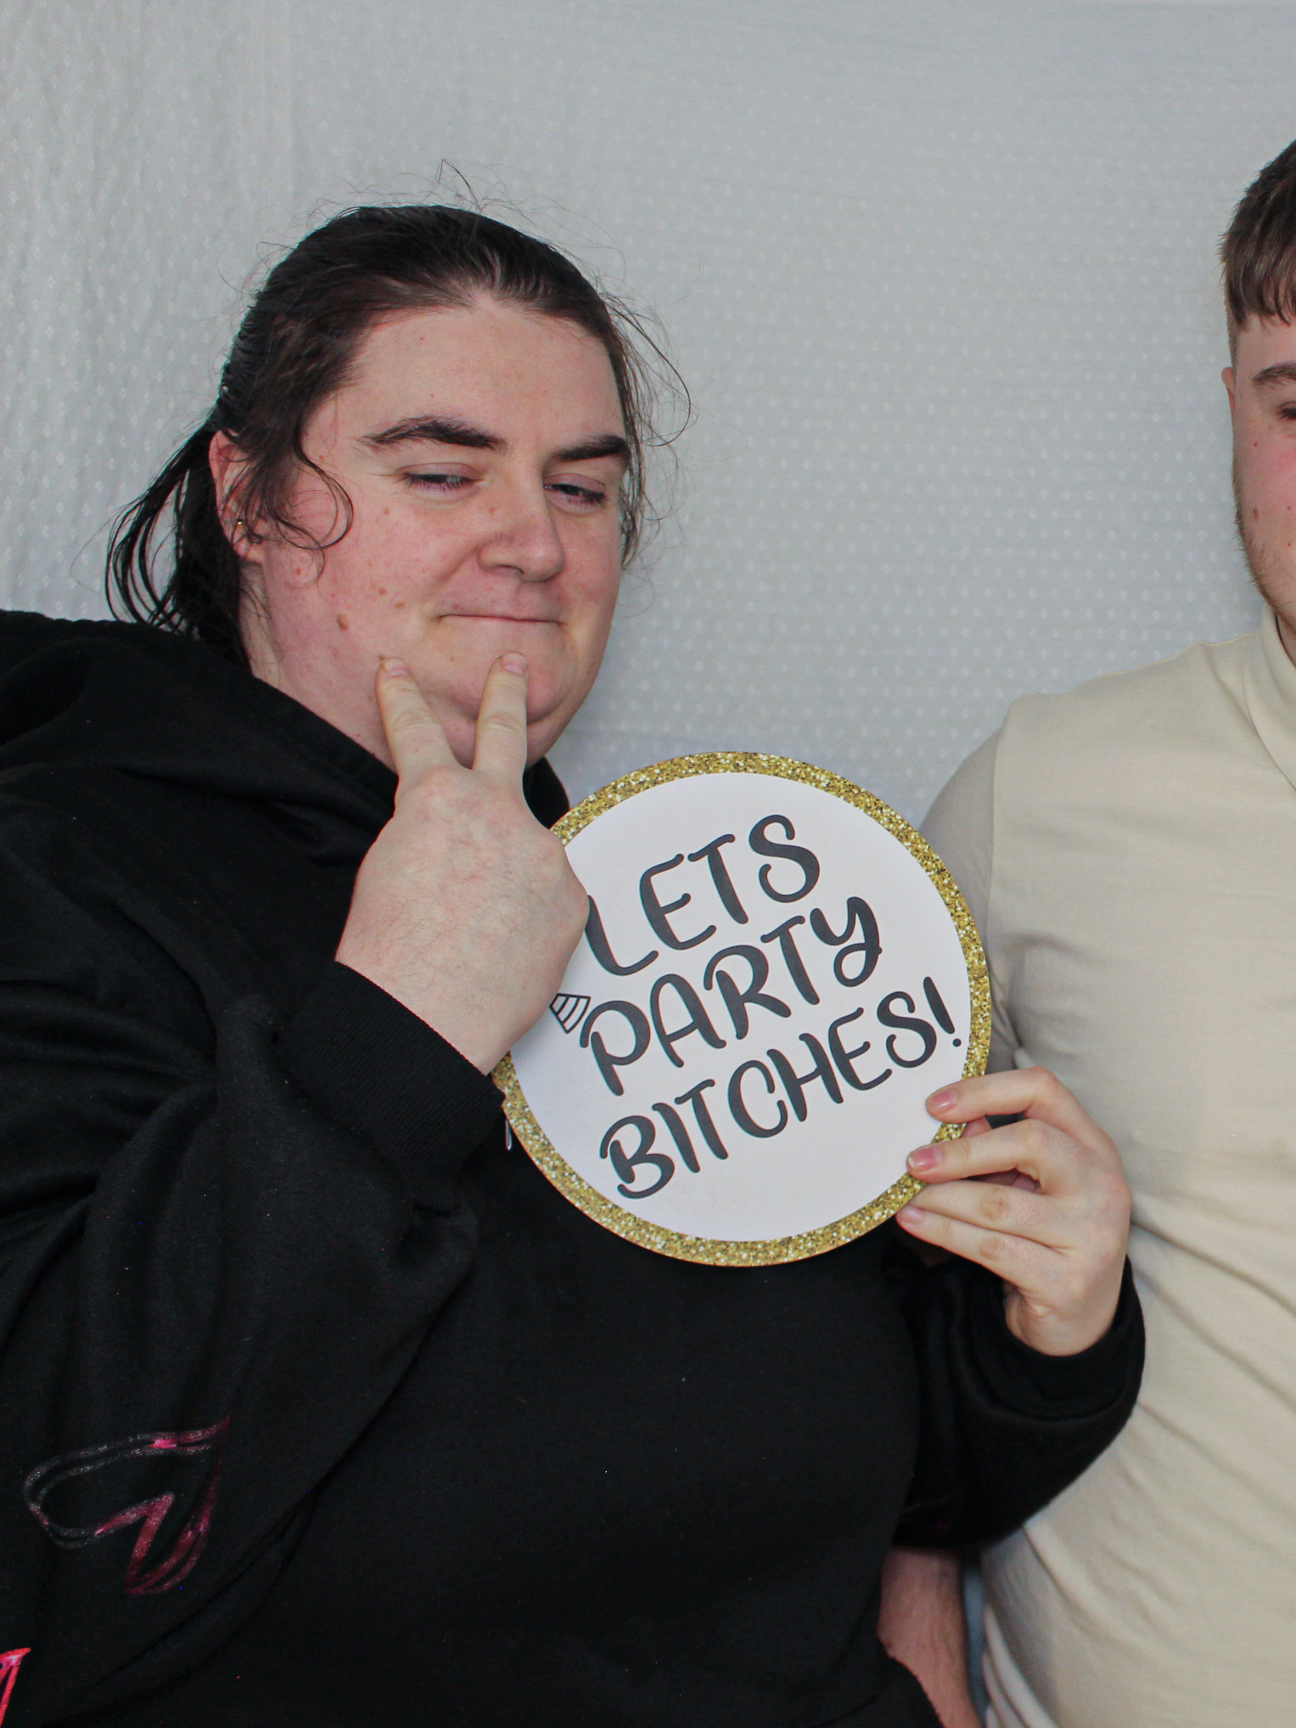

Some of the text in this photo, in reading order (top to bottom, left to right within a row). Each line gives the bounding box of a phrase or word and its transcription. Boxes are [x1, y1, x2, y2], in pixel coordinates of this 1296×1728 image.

[585, 814, 821, 976] LETS
[580, 896, 883, 1096] PARTY
[599, 976, 962, 1200] BITCHES!
